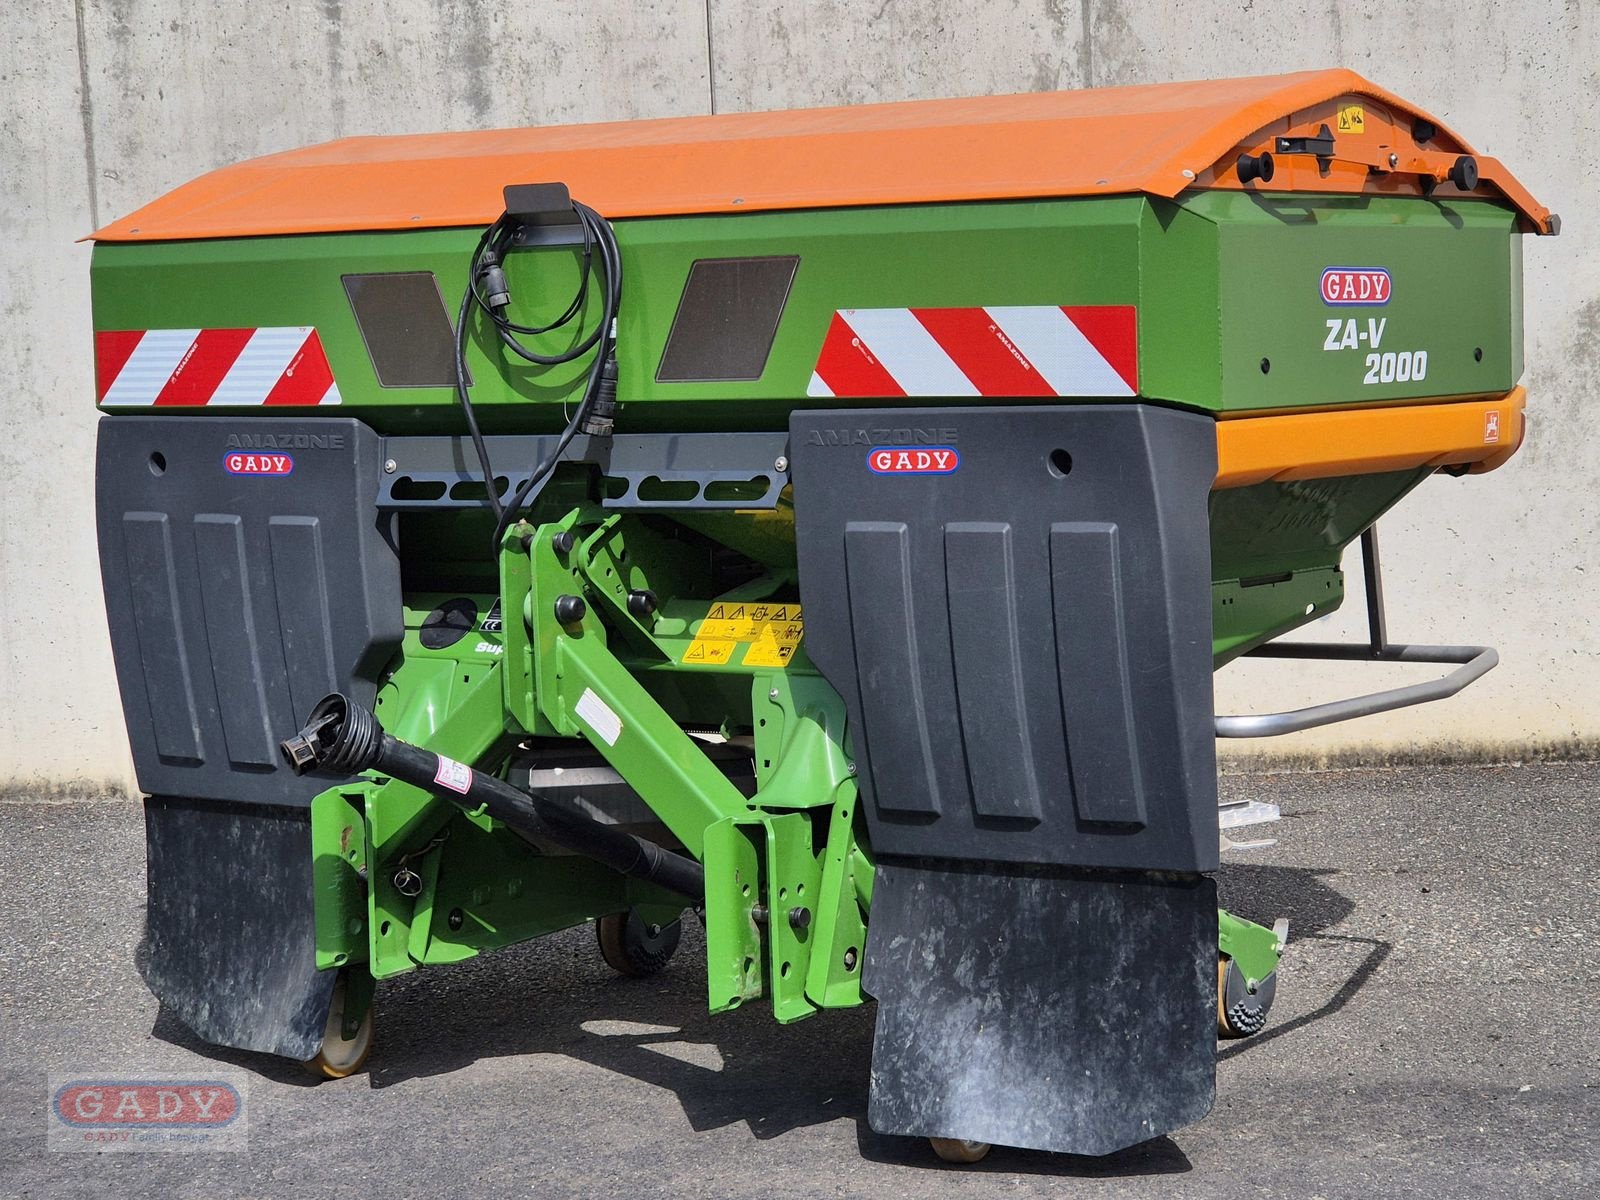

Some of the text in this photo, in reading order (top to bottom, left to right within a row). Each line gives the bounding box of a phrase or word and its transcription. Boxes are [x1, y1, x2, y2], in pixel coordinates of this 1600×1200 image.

[1327, 274, 1386, 300] GADY
[1323, 317, 1387, 351] ZA-V
[175, 342, 199, 377] AMAZONE
[996, 332, 1031, 371] AMAZONE
[1363, 350, 1428, 385] 2000
[224, 433, 345, 450] AMAZONE
[804, 428, 959, 447] AMAZONE
[230, 456, 286, 472] GADY
[876, 452, 950, 470] GADY
